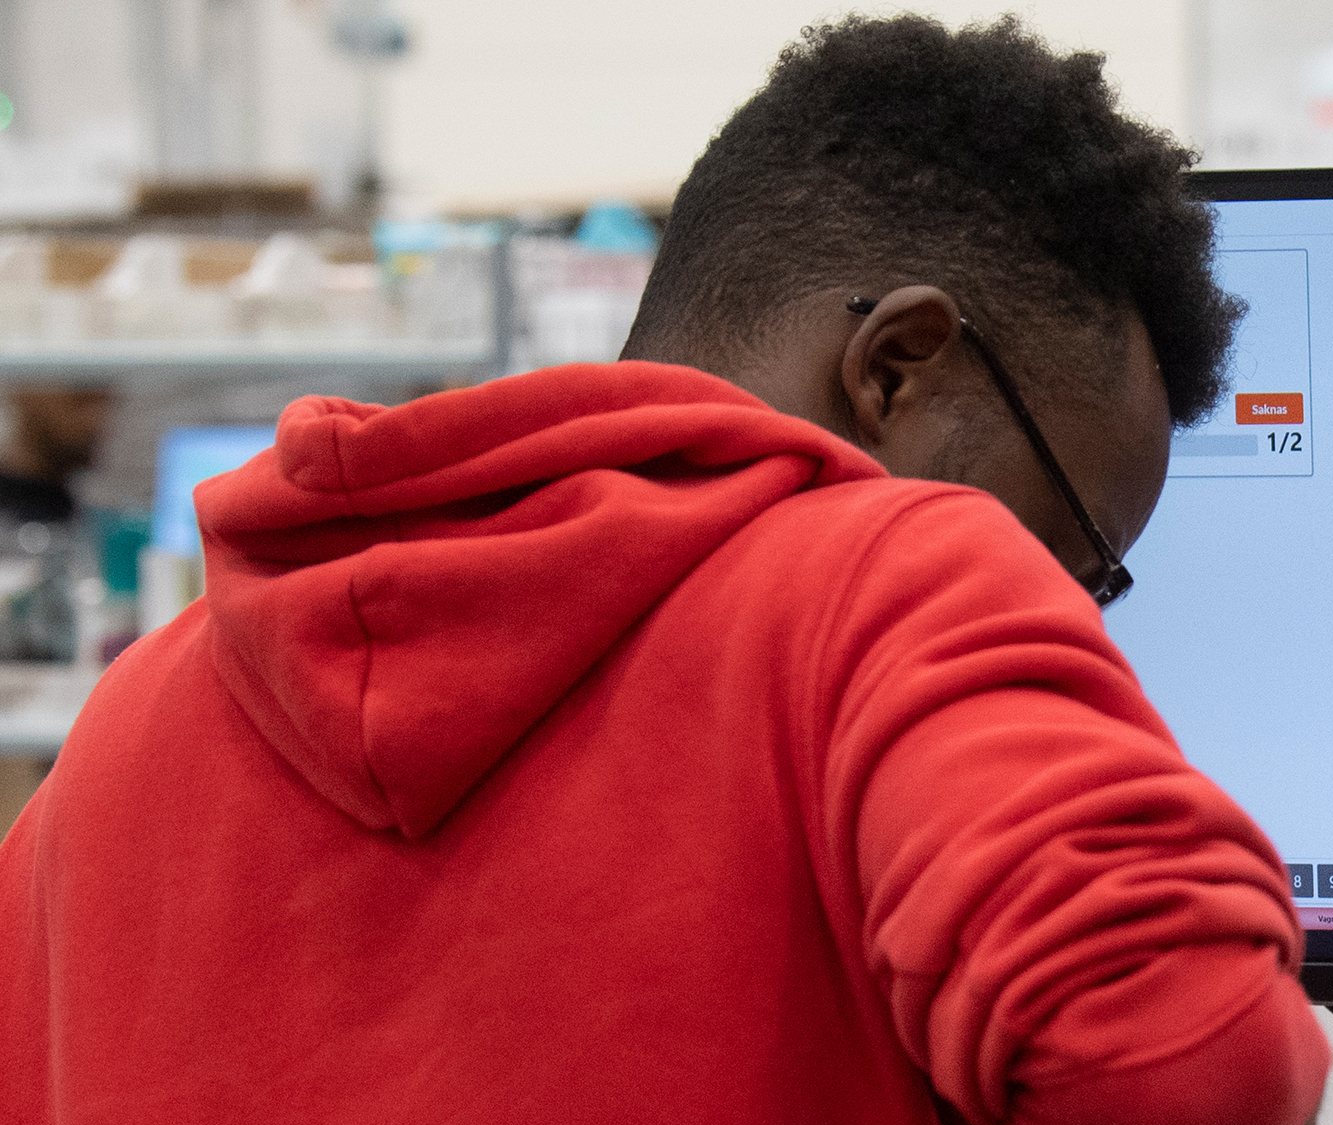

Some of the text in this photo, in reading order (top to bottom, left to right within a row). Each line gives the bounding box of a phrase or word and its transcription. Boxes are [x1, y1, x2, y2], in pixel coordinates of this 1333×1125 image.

[1252, 404, 1287, 415] Saknas
[1267, 432, 1303, 453] 1/2
[1294, 875, 1302, 888] 8
